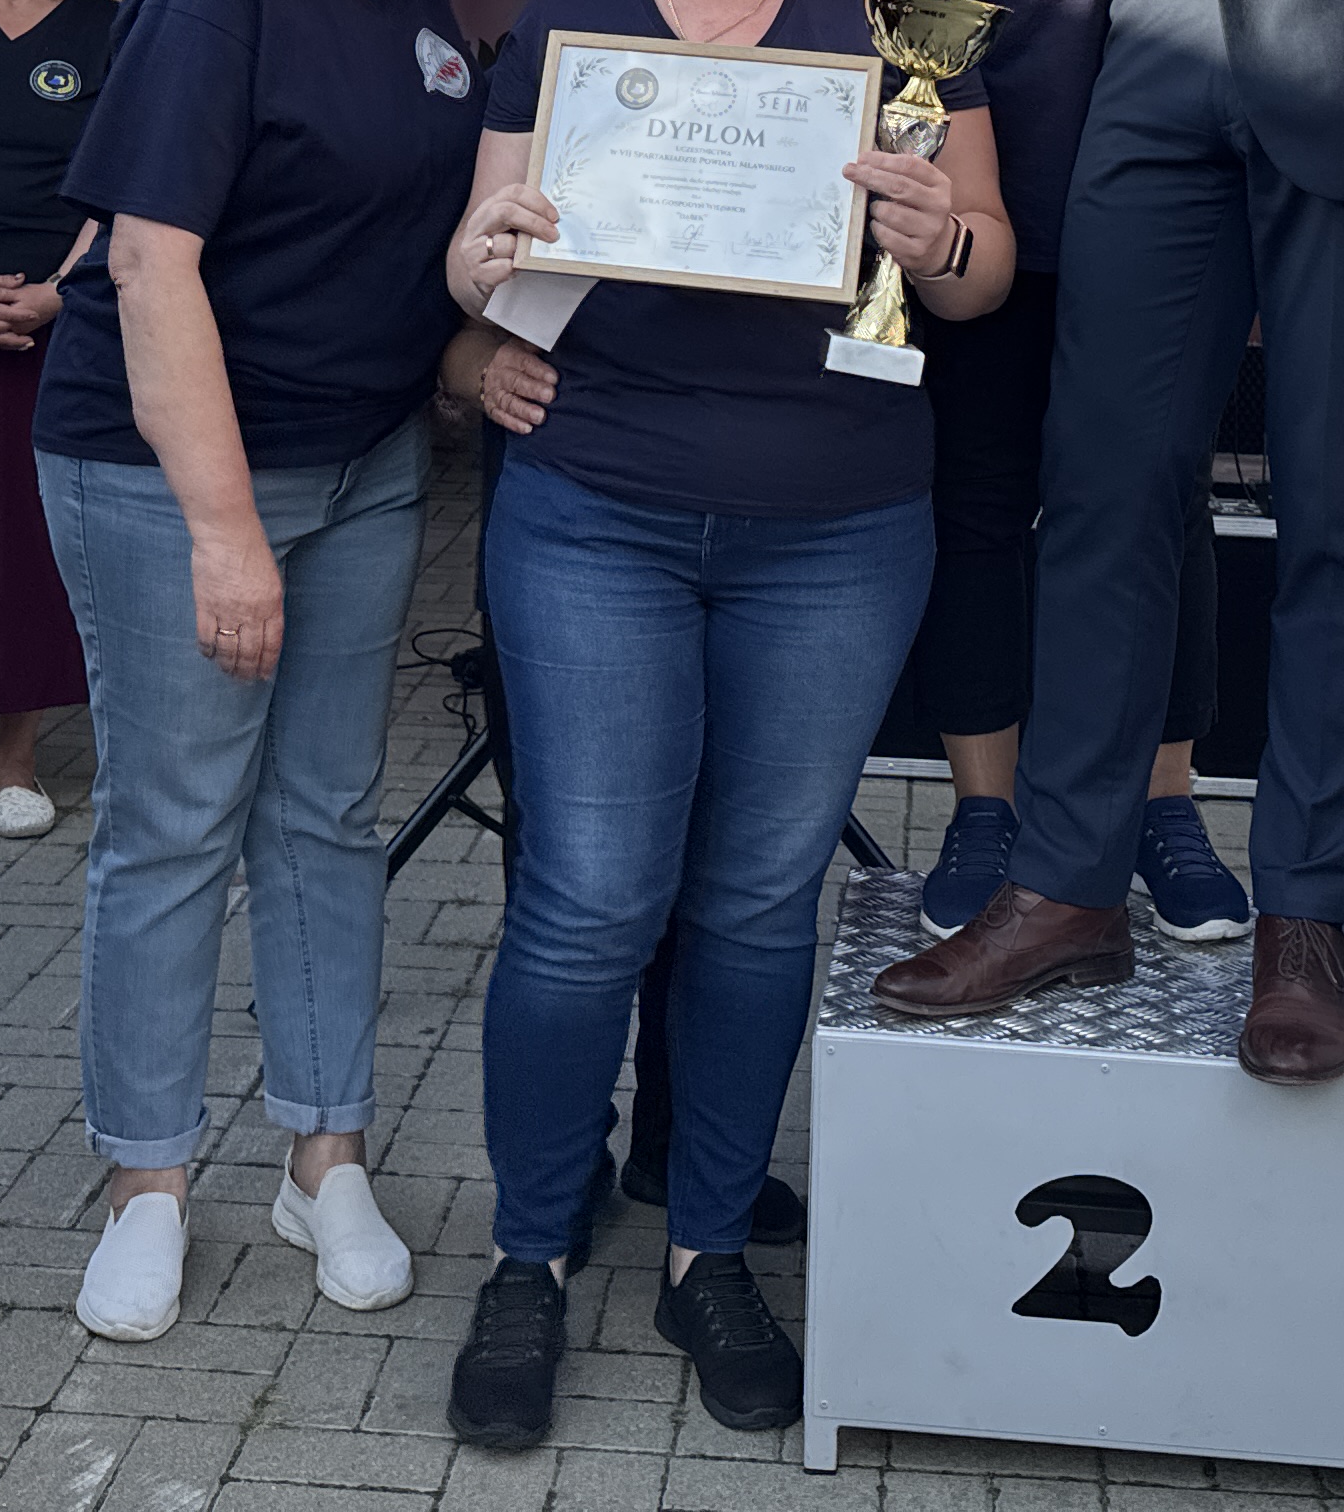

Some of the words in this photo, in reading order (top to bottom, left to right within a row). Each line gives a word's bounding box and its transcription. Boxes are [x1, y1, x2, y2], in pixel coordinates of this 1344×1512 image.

[758, 96, 808, 115] SEJM
[647, 118, 765, 148] DYPLOM
[1011, 1174, 1163, 1338] 2
